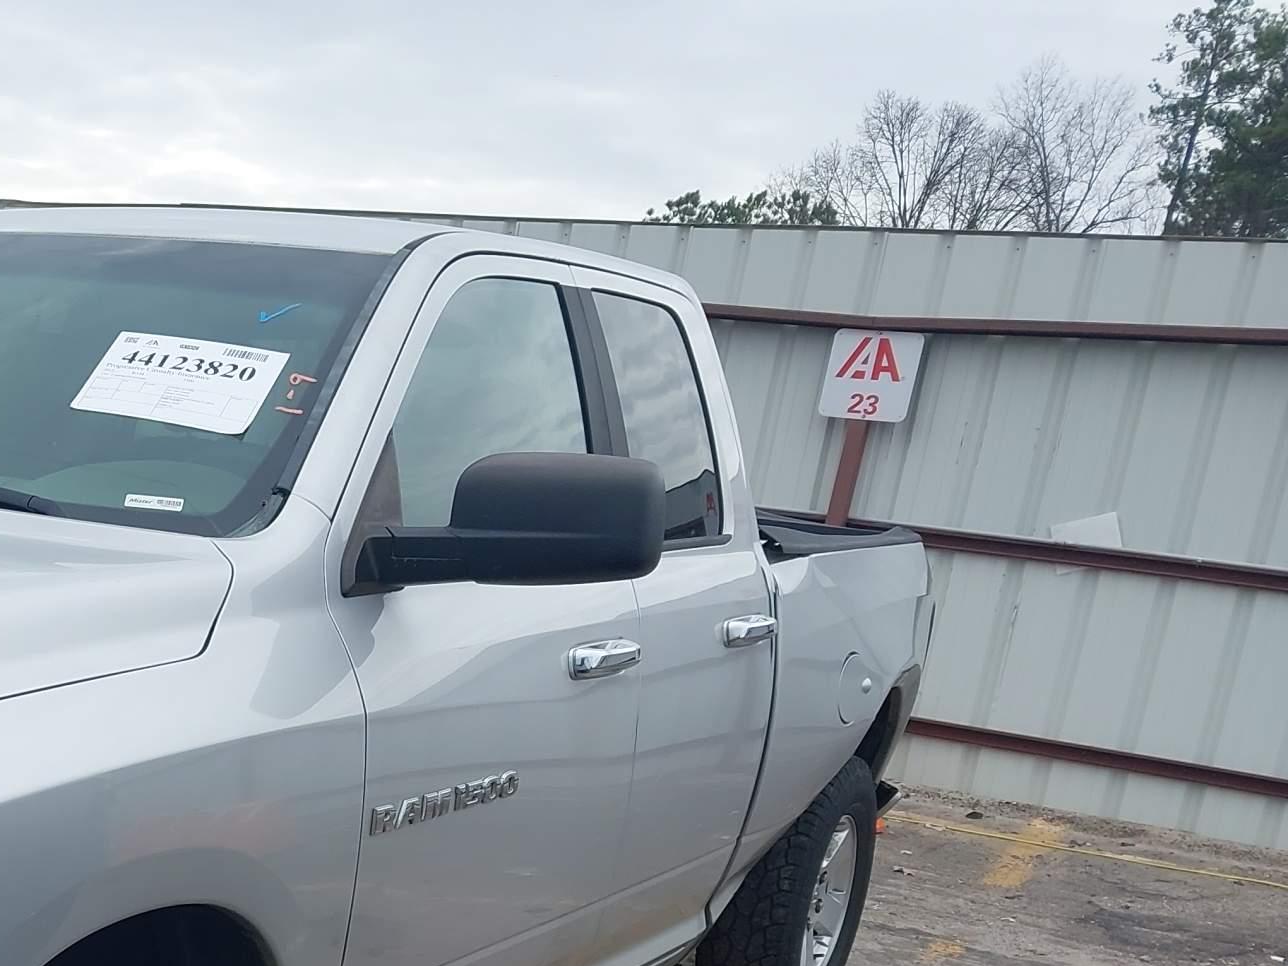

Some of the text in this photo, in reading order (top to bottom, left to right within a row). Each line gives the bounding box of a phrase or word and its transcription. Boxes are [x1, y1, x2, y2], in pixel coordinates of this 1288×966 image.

[121, 350, 256, 382] 44123820
[847, 393, 879, 415] 23
[369, 769, 520, 836] RAM 1500
